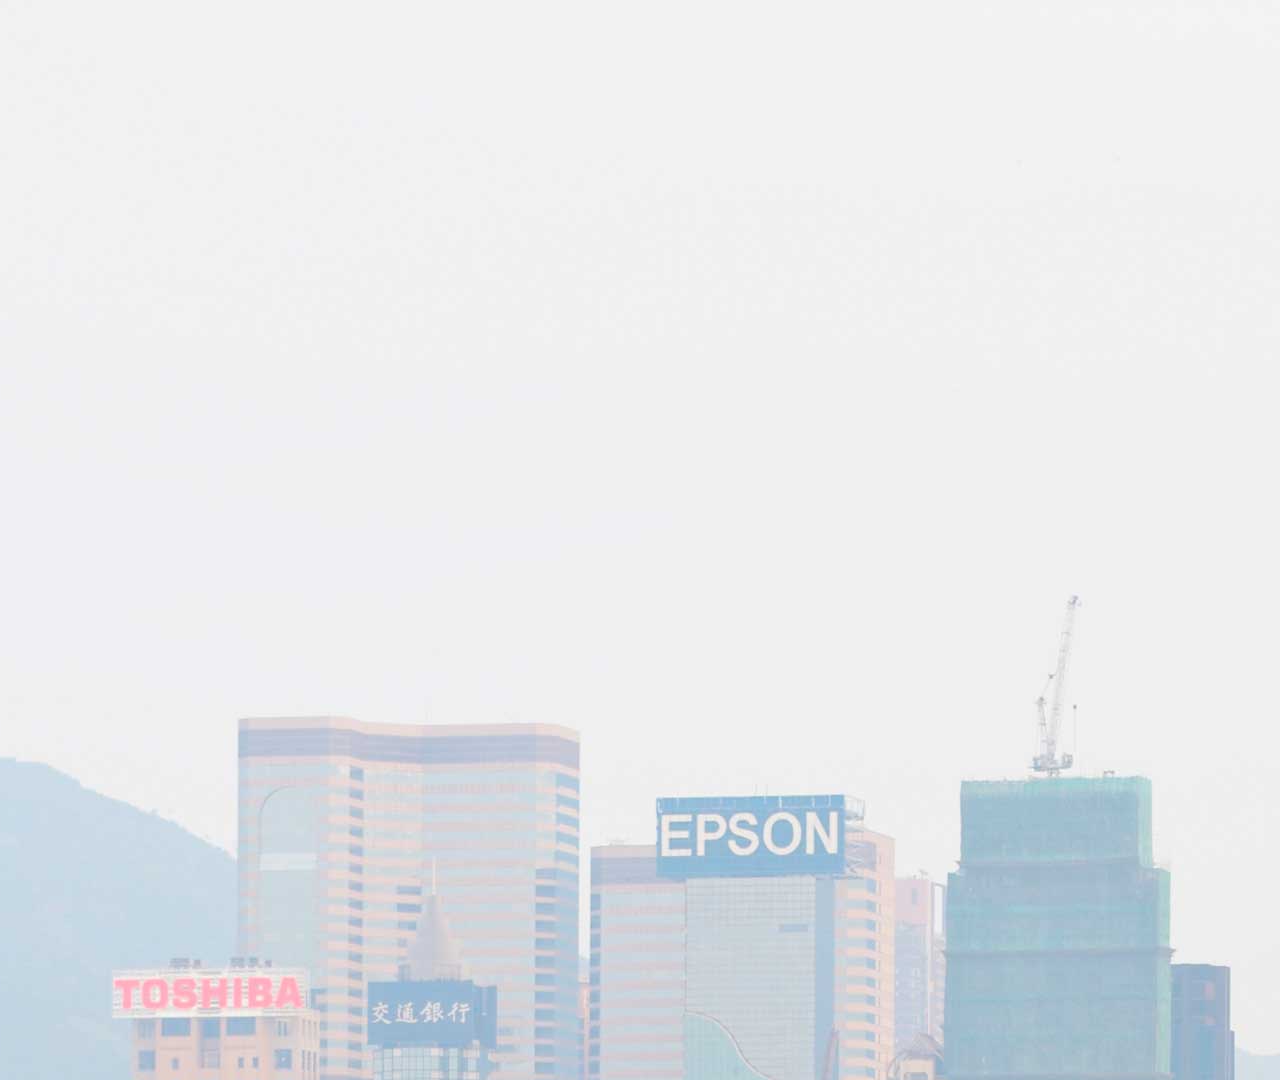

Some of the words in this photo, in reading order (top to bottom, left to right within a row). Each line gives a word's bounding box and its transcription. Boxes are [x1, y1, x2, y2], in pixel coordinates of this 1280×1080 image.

[661, 811, 839, 857] EPSON
[114, 976, 303, 1011] TOSHIBA
[371, 1000, 471, 1025] 交通銀行
